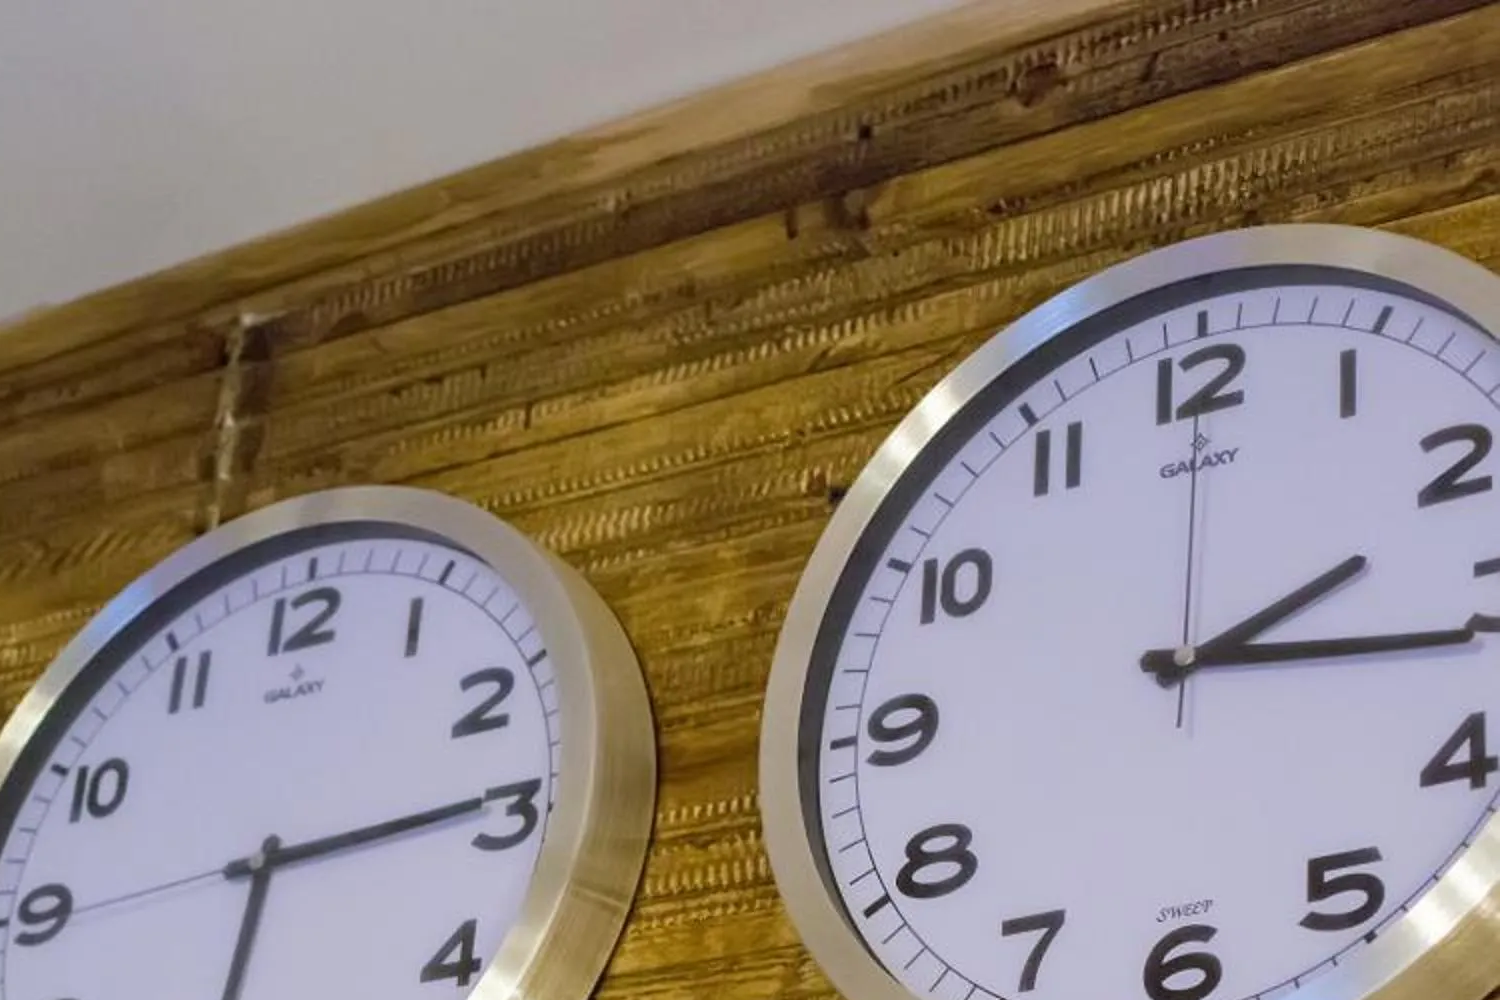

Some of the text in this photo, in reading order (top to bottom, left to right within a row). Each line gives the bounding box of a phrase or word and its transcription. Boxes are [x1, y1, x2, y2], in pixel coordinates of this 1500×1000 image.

[1156, 342, 1247, 426] 12
[1339, 349, 1358, 418] 1
[1032, 421, 1083, 498] 11
[1159, 447, 1240, 479] GALAXY
[1417, 423, 1494, 509] 2
[266, 586, 342, 656] 12
[919, 547, 993, 625] 10
[403, 597, 424, 658] 1
[167, 650, 212, 715] 11
[450, 666, 515, 739] 2
[866, 693, 940, 767] 9
[1419, 711, 1500, 790] 4
[69, 758, 129, 824] 10
[470, 777, 543, 851] 3
[895, 823, 978, 900] 8
[1299, 846, 1386, 932] 5
[14, 883, 73, 947] 9
[1001, 910, 1067, 993] 7
[419, 919, 482, 988] 4
